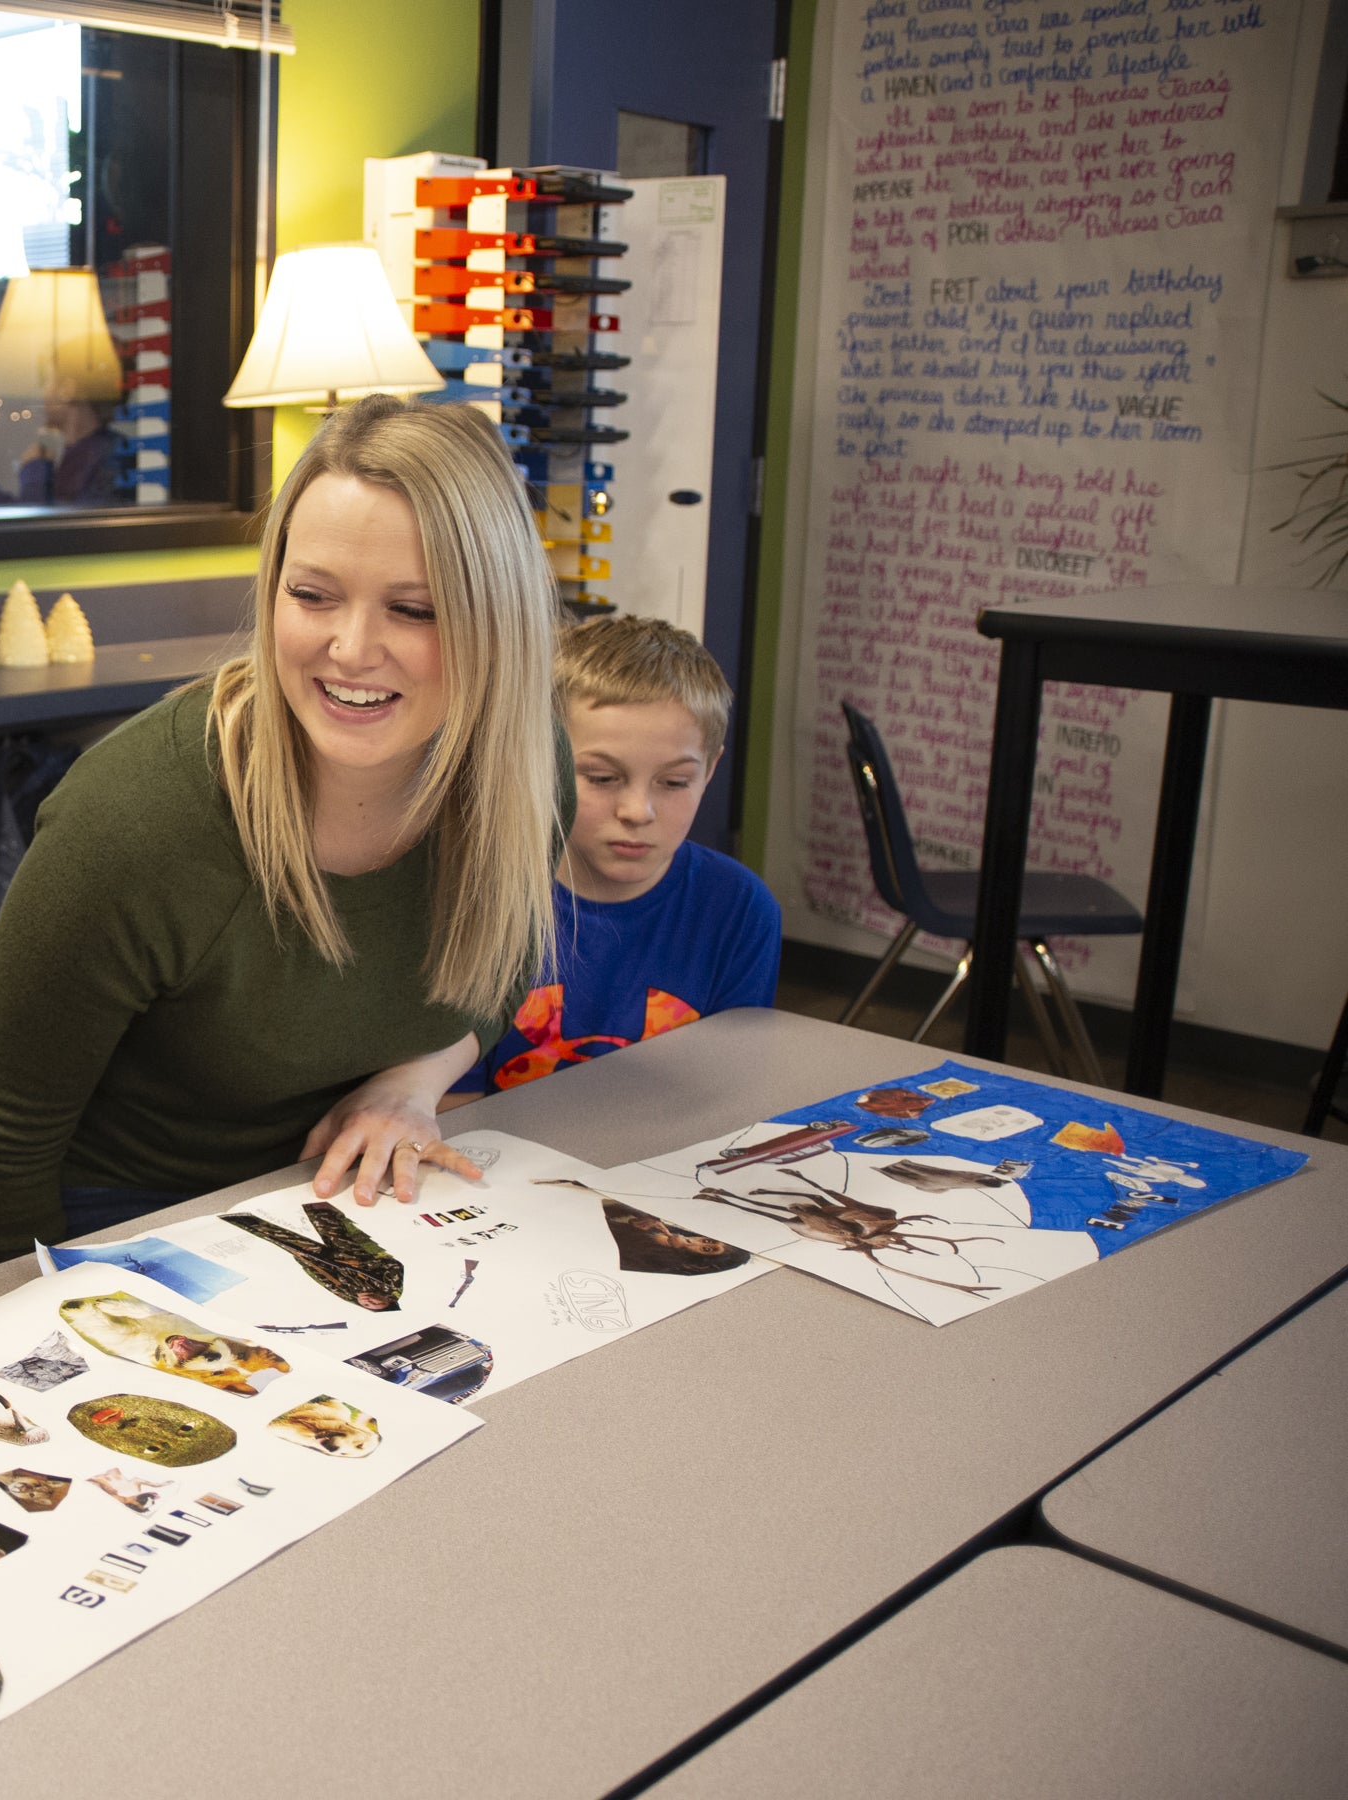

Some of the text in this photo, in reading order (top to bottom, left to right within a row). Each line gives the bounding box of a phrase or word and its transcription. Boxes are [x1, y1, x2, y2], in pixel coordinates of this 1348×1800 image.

[1080, 13, 1161, 57] provide
[1166, 16, 1216, 40] her
[884, 73, 938, 101] HAVEN
[940, 71, 975, 93] and
[999, 56, 1093, 95] comfortable
[1126, 94, 1229, 128] wondered
[1160, 126, 1188, 152] to
[852, 178, 915, 202] APPEASE
[1167, 151, 1236, 182] going
[1189, 177, 1233, 200] can
[946, 219, 990, 246] POSH
[930, 262, 1223, 311] FRET about your birthday
[1105, 301, 1196, 336] replied
[1072, 332, 1189, 366] discussing
[1020, 383, 1060, 408] like
[1115, 394, 1185, 421] VAGUE
[963, 412, 1043, 444] stomped
[1104, 415, 1143, 441] her
[1074, 467, 1117, 497] told
[1120, 467, 1166, 498] his
[1023, 496, 1102, 528] special
[1015, 545, 1097, 577] DISCREET
